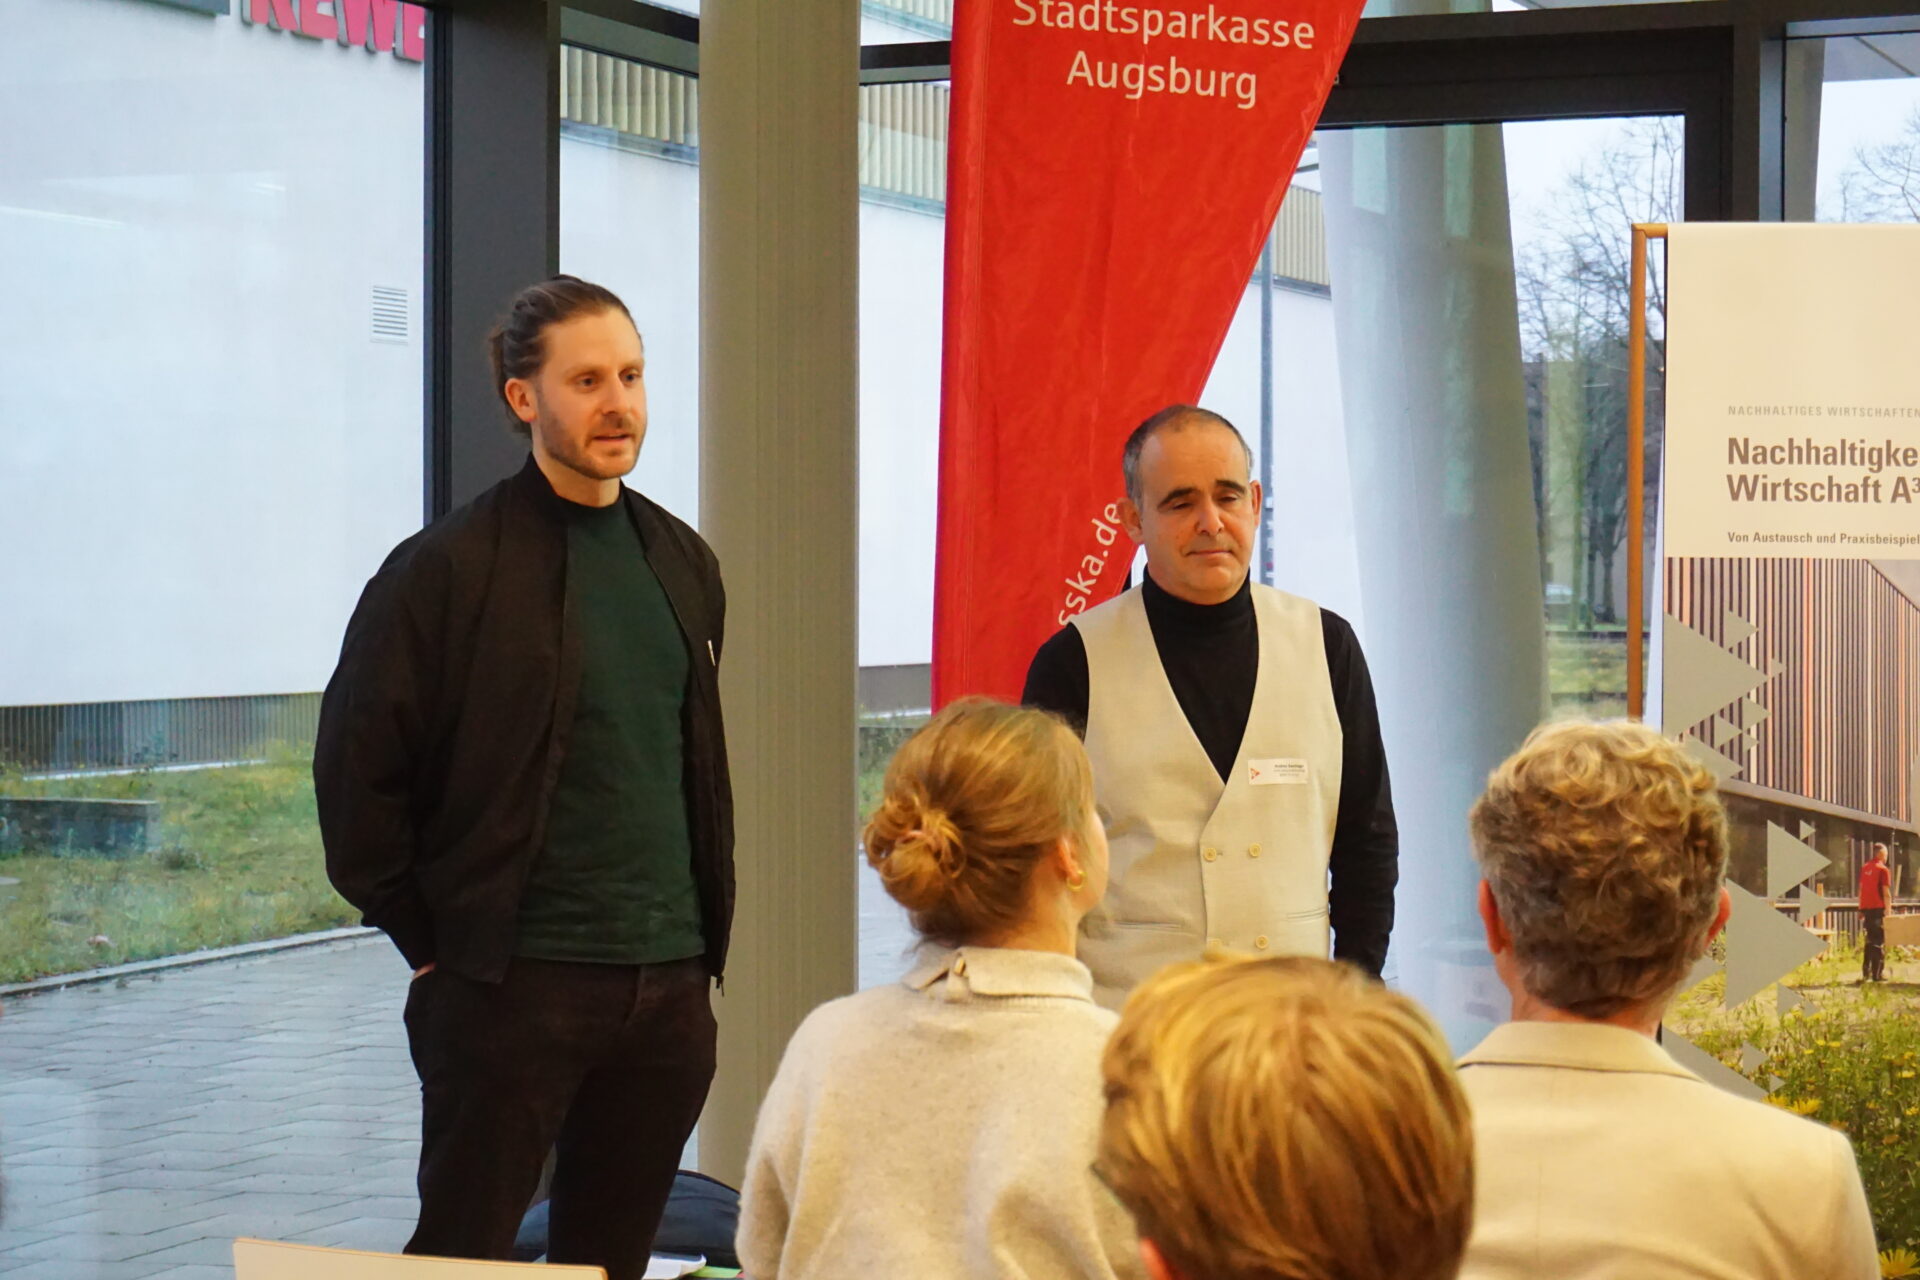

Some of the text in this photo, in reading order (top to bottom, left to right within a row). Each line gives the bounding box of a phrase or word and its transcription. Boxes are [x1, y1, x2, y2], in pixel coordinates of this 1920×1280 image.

[1012, 0, 1315, 49] Stadtsparkasse
[1066, 50, 1257, 110] Augsburg
[1728, 405, 1920, 419] NACHHALTIGES WIRTSCHAFTEN
[1728, 437, 1919, 474] Nachhaltigke
[1726, 474, 1882, 504] Wirtschaft
[1728, 532, 1920, 547] Von Austausch und Praxisbeispiel
